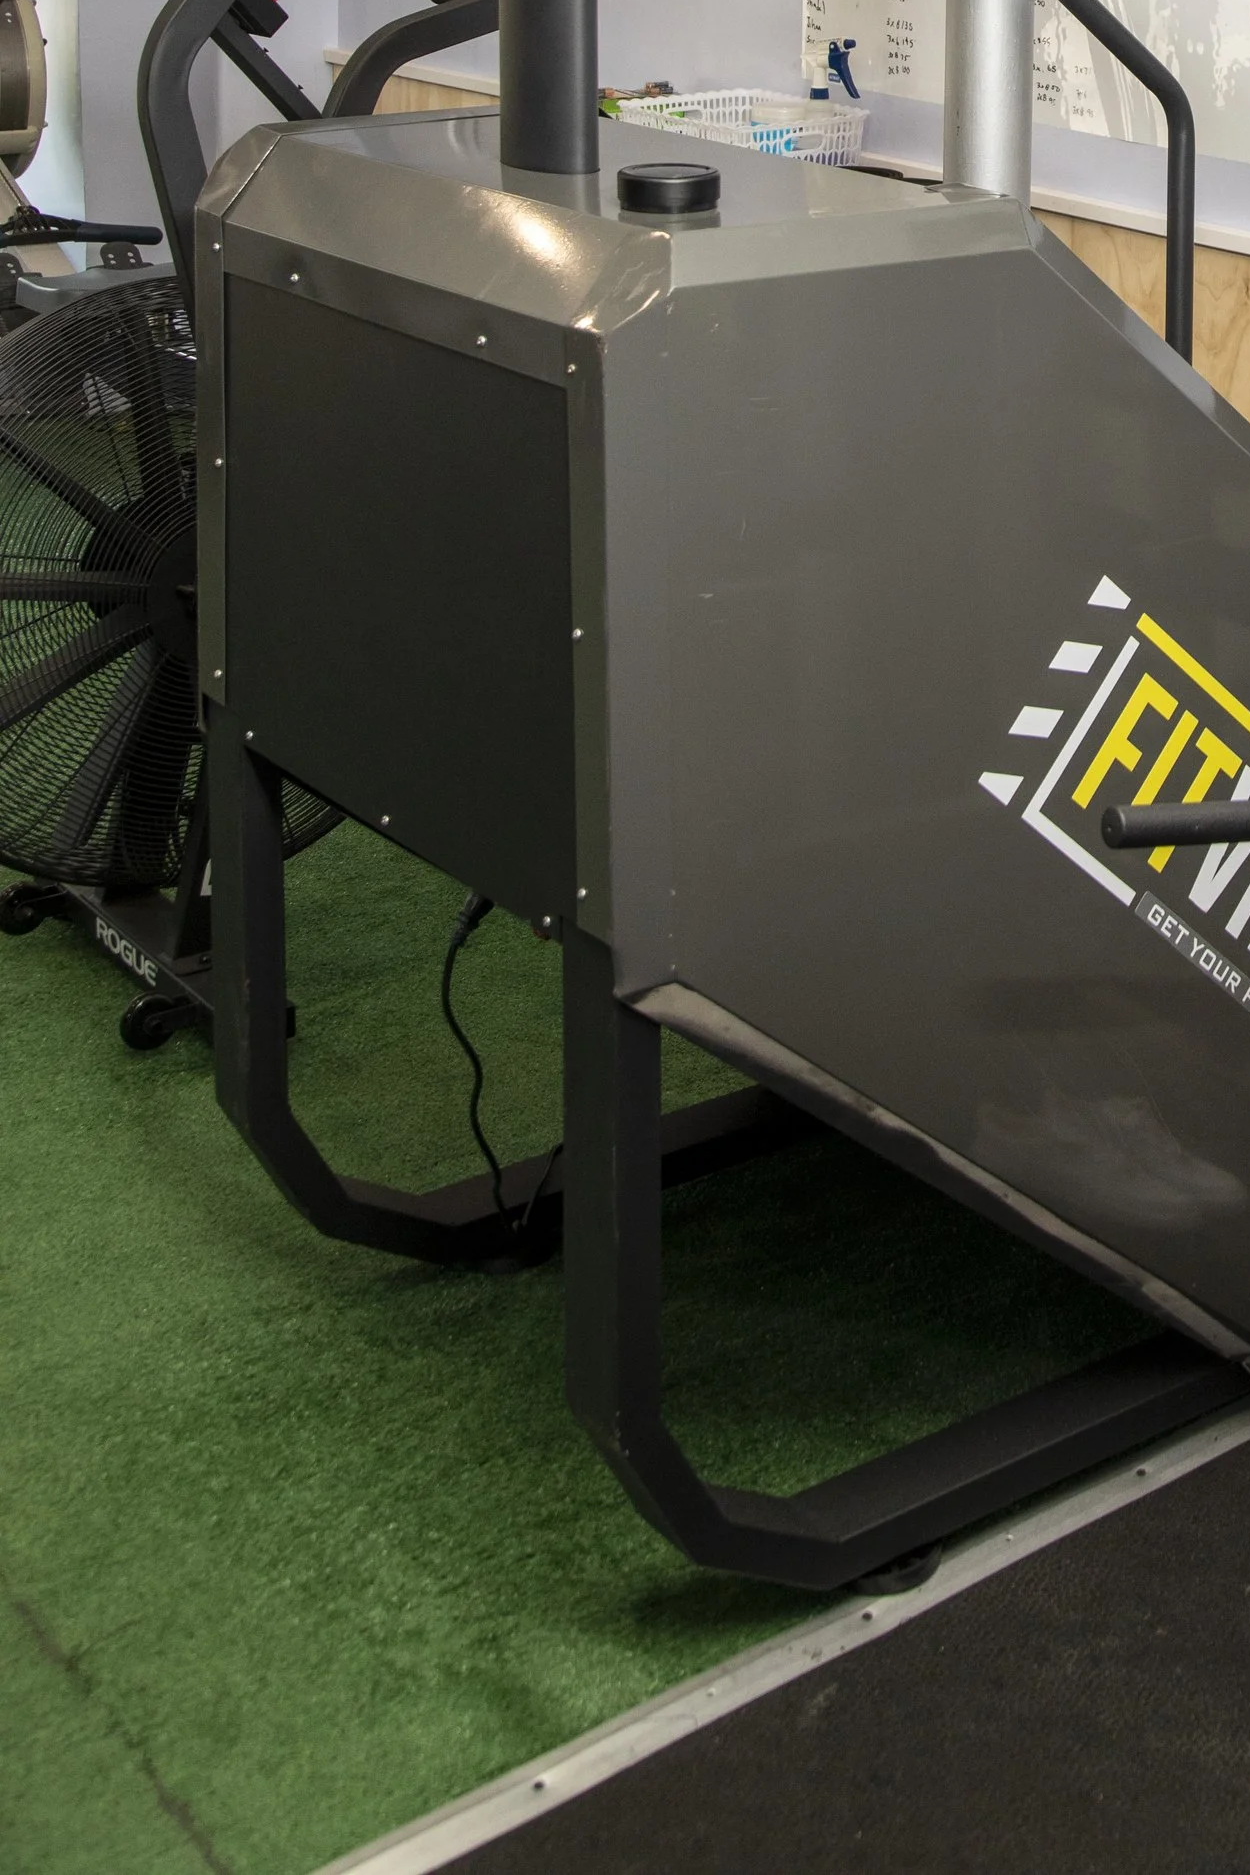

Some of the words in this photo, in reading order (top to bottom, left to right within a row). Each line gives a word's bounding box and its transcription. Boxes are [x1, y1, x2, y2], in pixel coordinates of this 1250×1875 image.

[95, 916, 159, 988] ROGUE
[1146, 904, 1191, 948] GET
[1190, 937, 1242, 1000] YOUR
